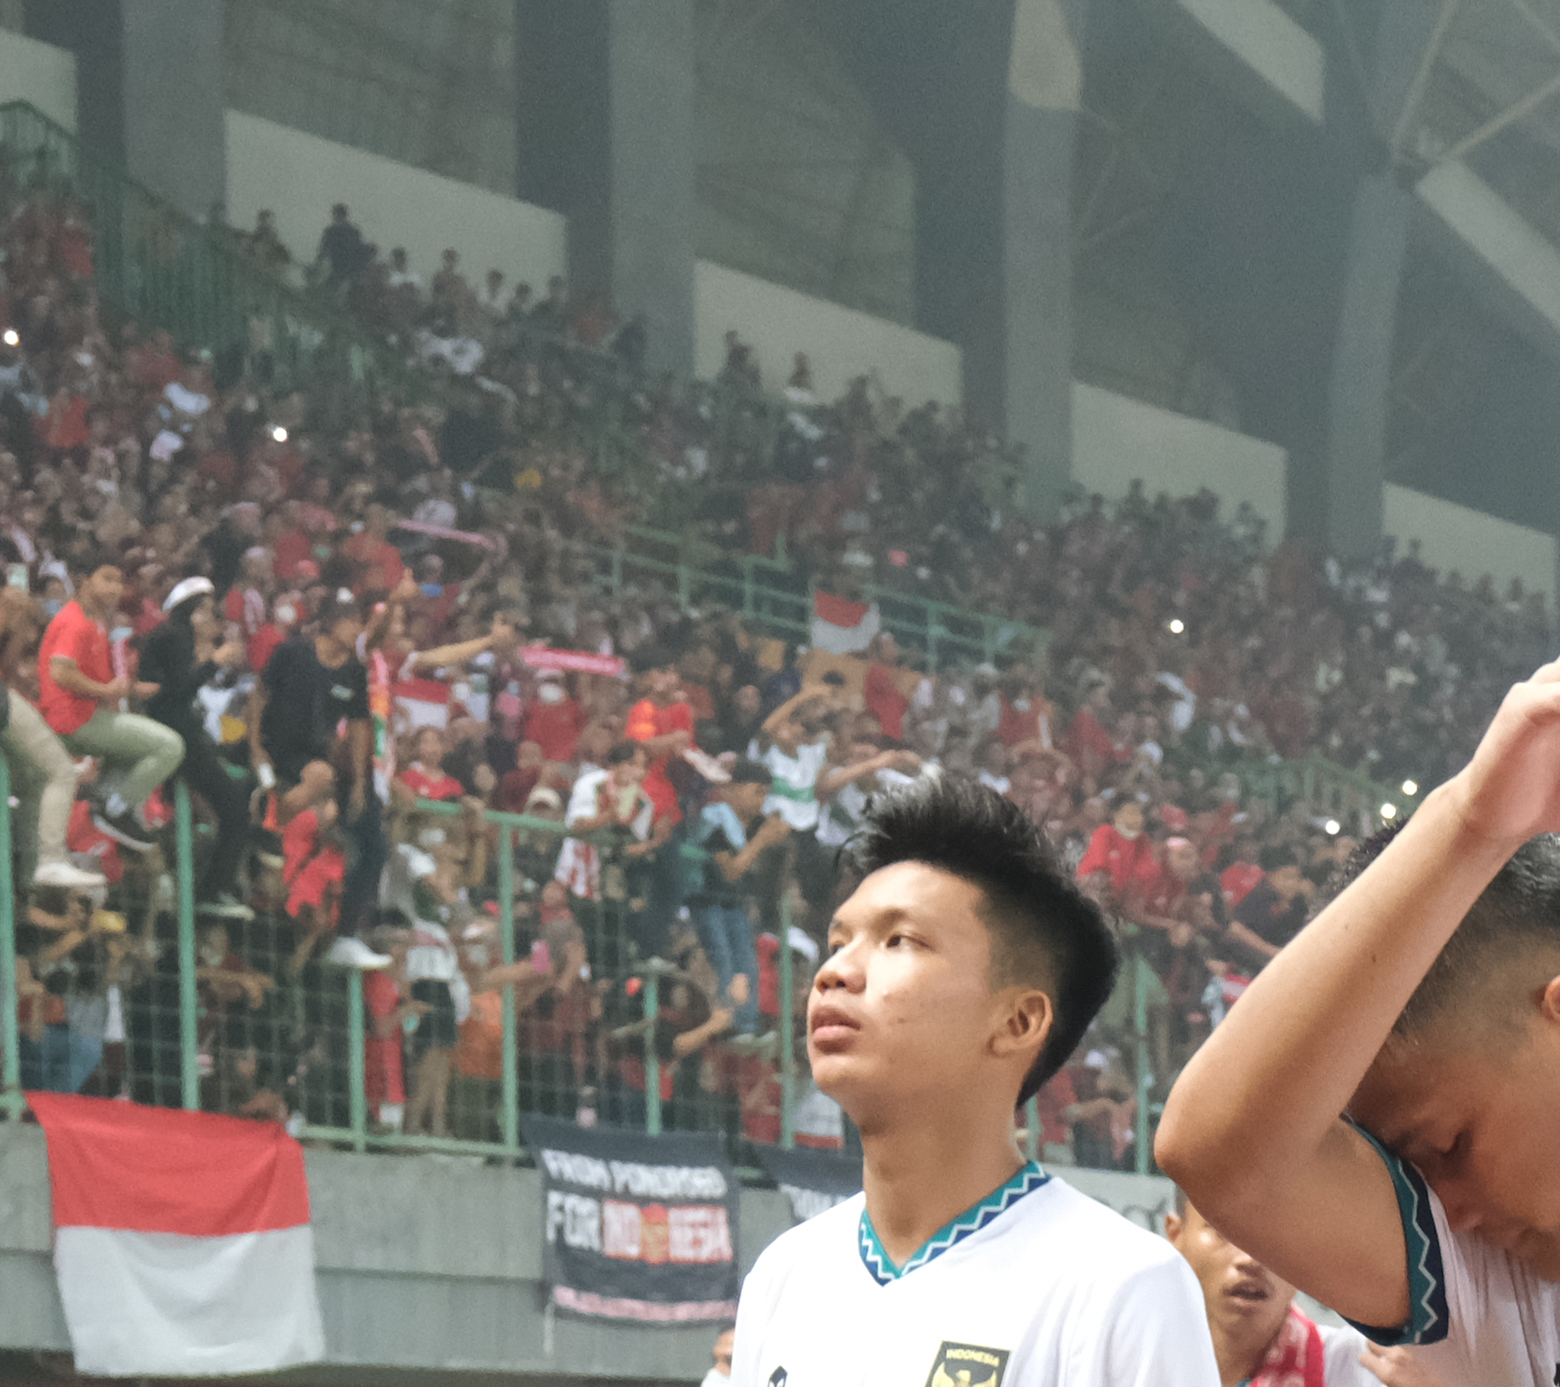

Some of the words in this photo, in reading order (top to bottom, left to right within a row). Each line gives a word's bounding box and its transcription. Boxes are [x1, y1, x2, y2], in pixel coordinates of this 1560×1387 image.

[542, 1148, 611, 1192] FROM
[546, 1190, 602, 1251] FOR
[946, 1348, 1000, 1368] INDONESIA
